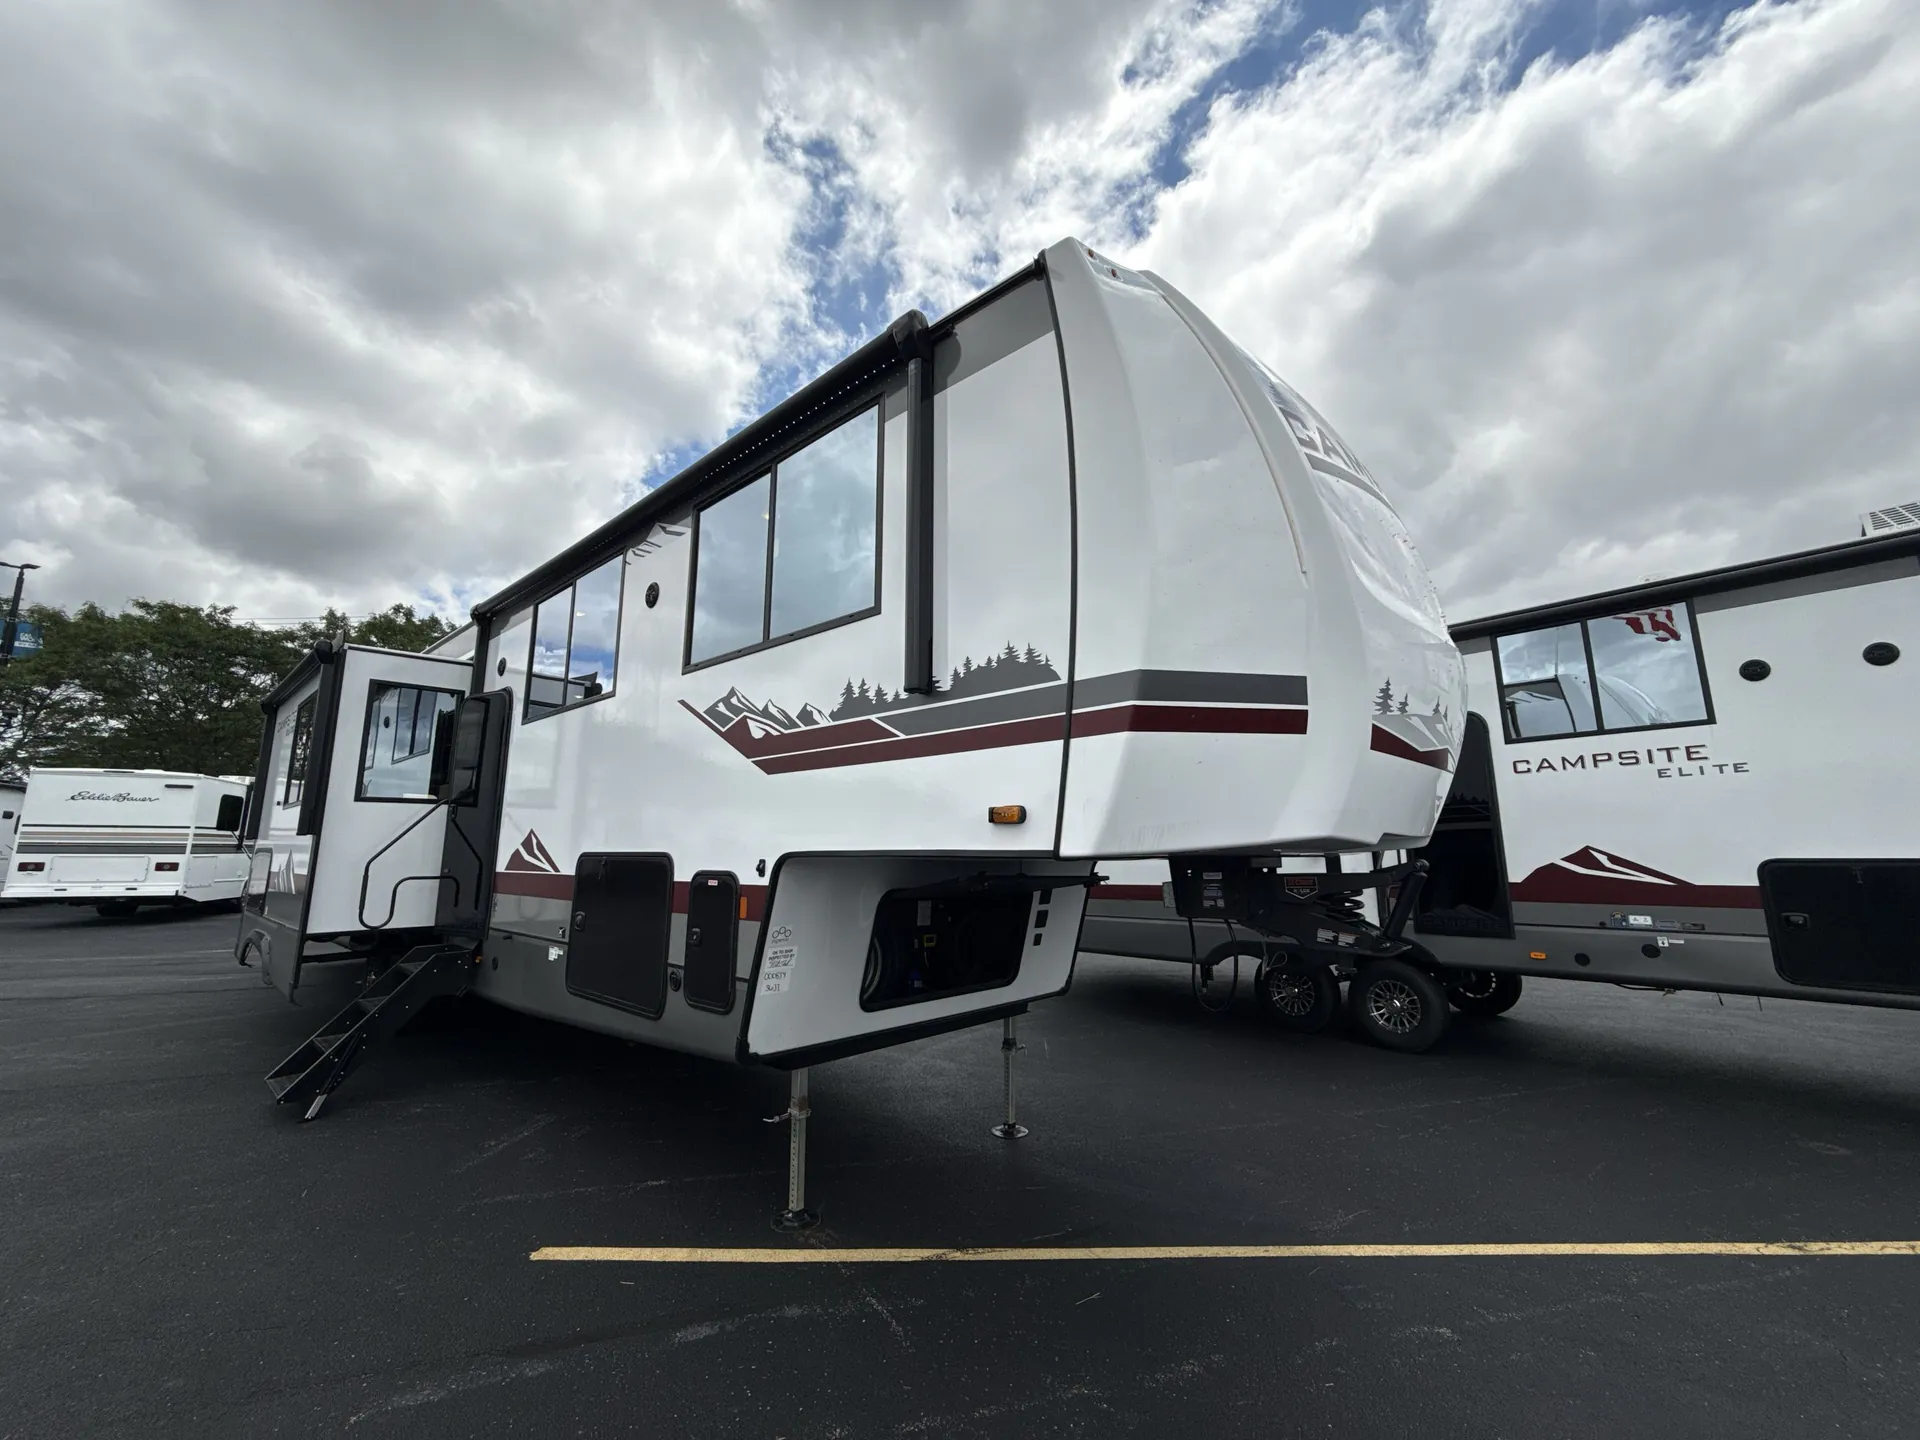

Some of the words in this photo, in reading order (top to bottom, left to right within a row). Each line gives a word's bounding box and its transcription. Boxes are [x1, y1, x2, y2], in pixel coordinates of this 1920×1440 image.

[1512, 744, 1710, 774] CAMPSITE
[1657, 762, 1750, 778] ELITE
[65, 791, 111, 801] Eddie
[110, 792, 160, 802] Bauer
